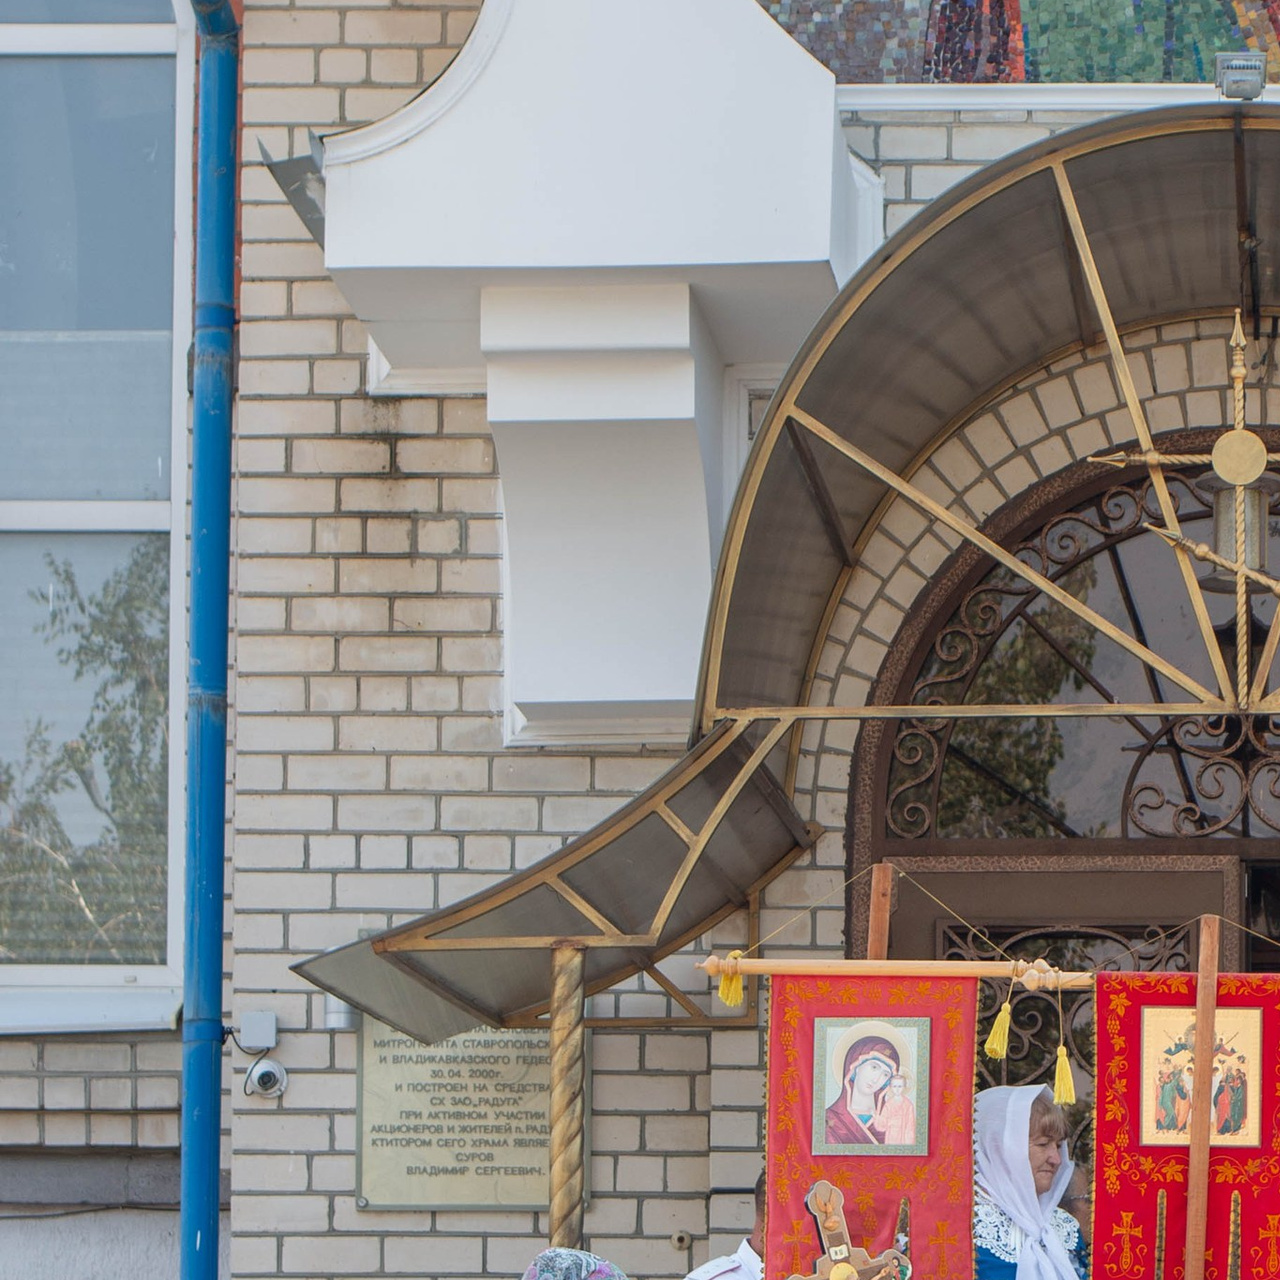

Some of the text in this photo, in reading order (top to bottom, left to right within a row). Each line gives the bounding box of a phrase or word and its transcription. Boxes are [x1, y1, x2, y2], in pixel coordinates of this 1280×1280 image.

[373, 1038, 550, 1049] МИТРОПИТА СТАВРОПОЛЬСК
[379, 1055, 551, 1065] И ВЛАДИКАВКАЗСКОГО ГЕДЕО
[395, 1083, 403, 1092] И
[407, 1082, 468, 1093] ПОСТРОЕН
[473, 1083, 488, 1092] НА
[400, 1110, 546, 1120] ПРИ АКТИВНОМ УЧАСТИИ
[370, 1124, 443, 1135] АКЦИОНЕРОВ
[447, 1124, 455, 1133] И
[458, 1121, 512, 1134] ЖИТЕЛЕЙ
[371, 1138, 550, 1148] КТИТОРОМ СЕГО ХРАМА ЯВЛЯЕ
[455, 1152, 494, 1162] СУРОВ
[406, 1166, 469, 1177] ВЛАДИМИР
